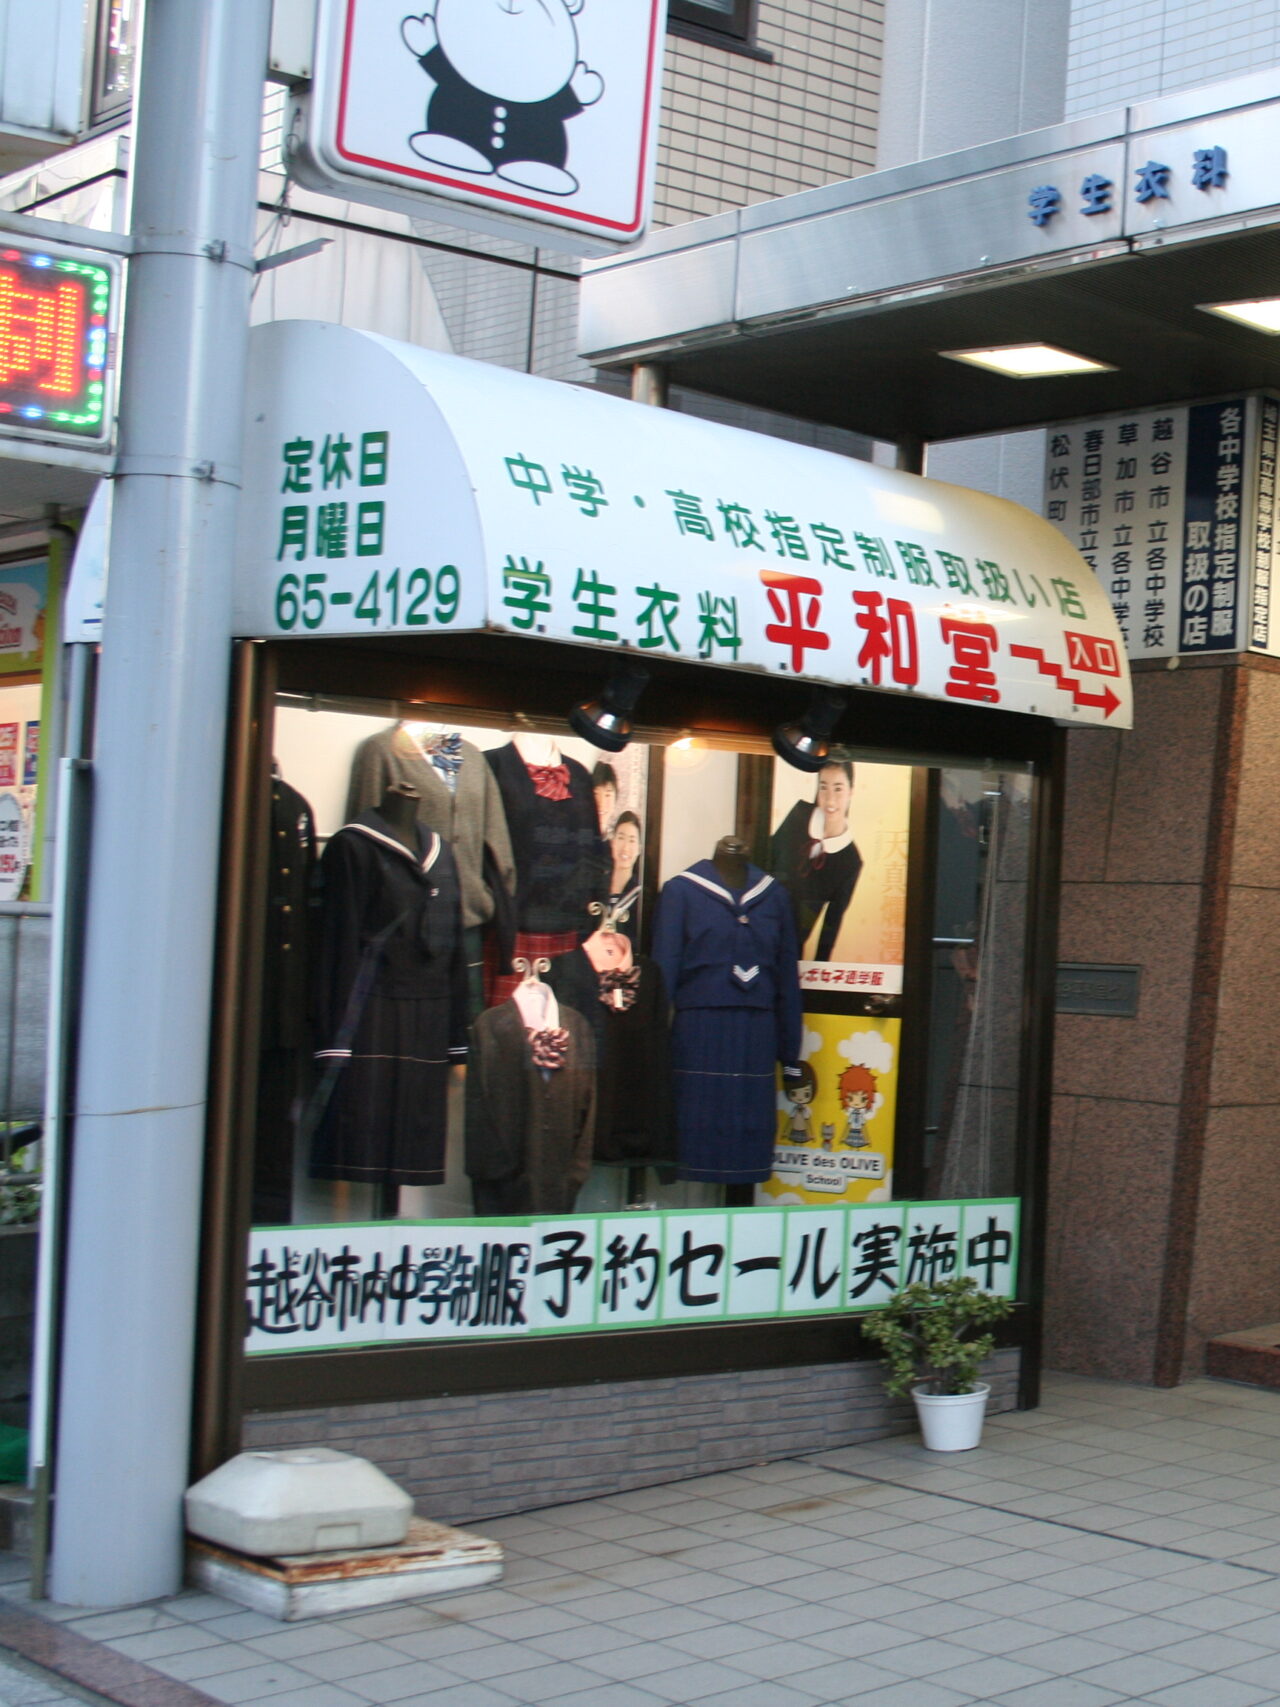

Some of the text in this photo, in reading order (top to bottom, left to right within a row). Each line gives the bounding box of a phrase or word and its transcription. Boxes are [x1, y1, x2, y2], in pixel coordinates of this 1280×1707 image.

[280, 431, 389, 495] 定休日
[1048, 434, 1071, 522] 松伏町
[277, 501, 386, 562] 月曜日
[504, 452, 1087, 622] 中学・高校指定制服取扱い店
[1142, 417, 1174, 649] 越谷市立各中学校
[1210, 408, 1242, 637] 各中学校指定制服
[274, 564, 462, 631] 65-4129
[1183, 521, 1212, 646] 取扱の店
[502, 554, 1001, 704] 学生衣料 平和堂
[1069, 635, 1117, 675] 入口
[806, 1174, 842, 1187] School
[812, 1156, 836, 1168] des
[840, 1157, 880, 1172] OLIVE
[535, 1216, 1013, 1319] 予約セール実施中
